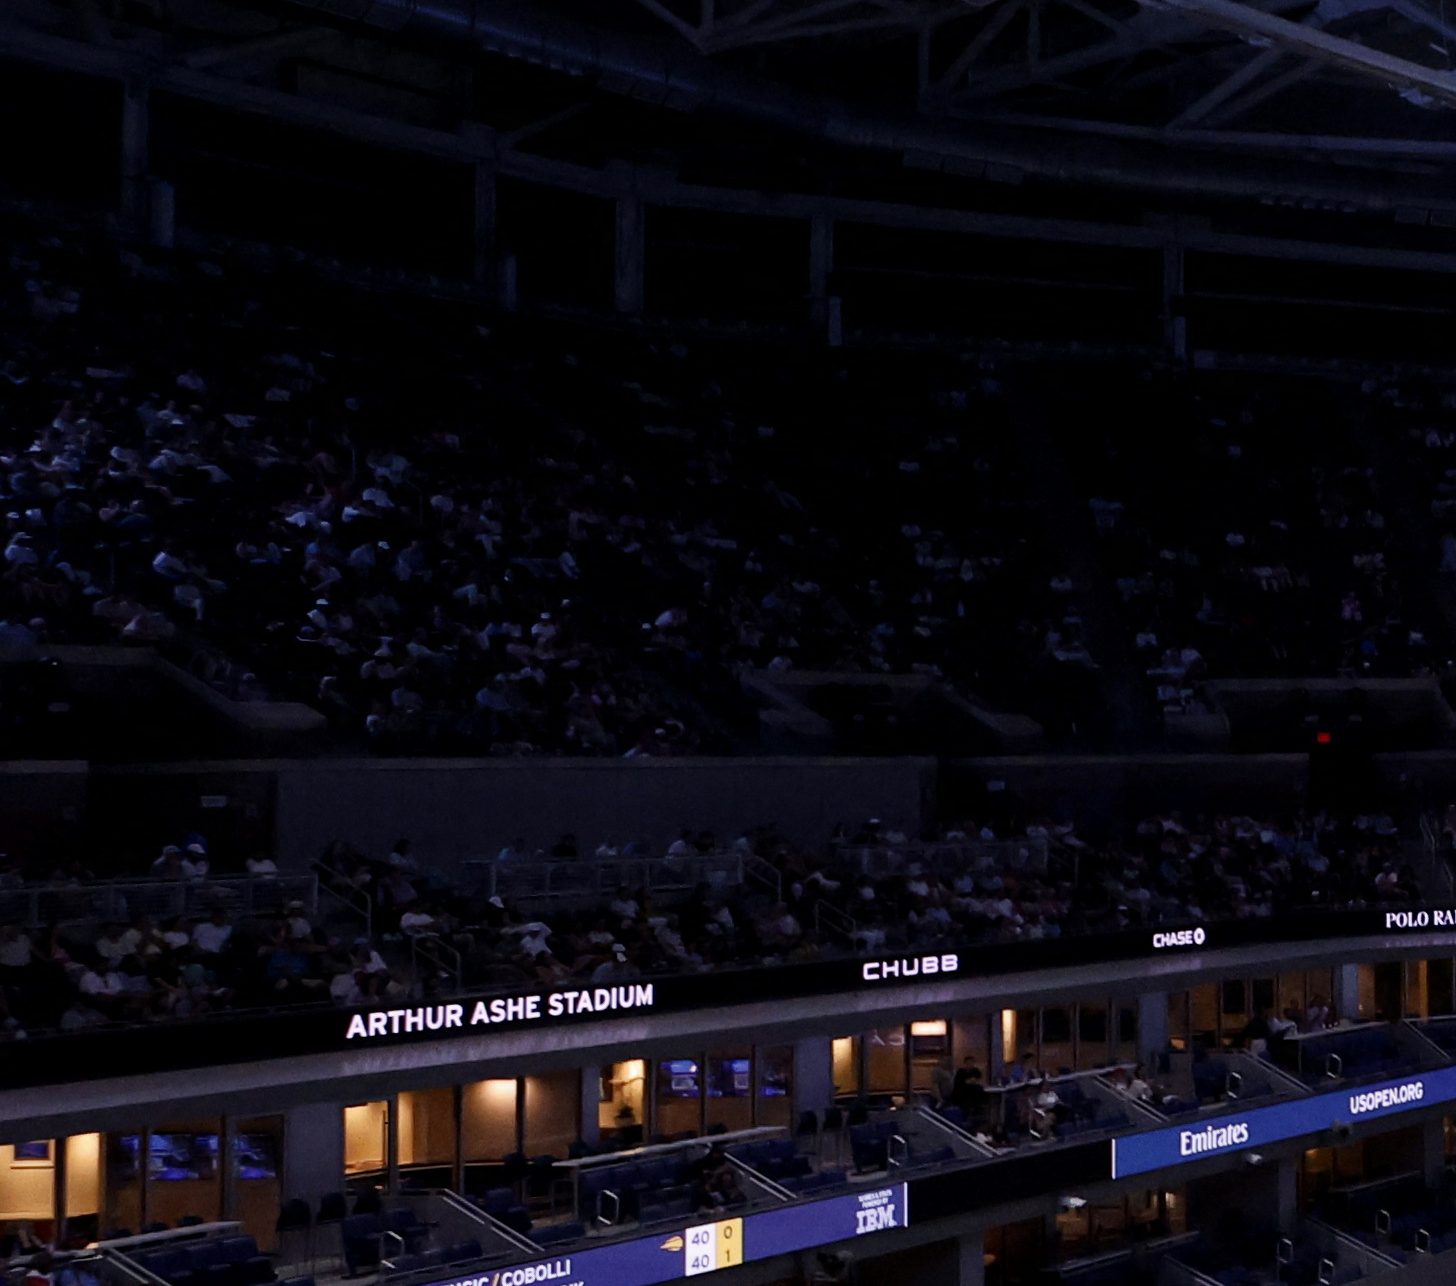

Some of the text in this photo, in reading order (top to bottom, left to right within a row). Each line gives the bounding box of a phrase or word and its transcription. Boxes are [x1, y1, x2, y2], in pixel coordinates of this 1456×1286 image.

[1386, 912, 1429, 928] POLO
[1153, 931, 1193, 947] CHASE
[863, 955, 957, 980] CHUBB
[347, 984, 653, 1038] ARTHUR ASHE STADIUM
[1350, 1082, 1423, 1114] USOPEN.ORG
[1181, 1123, 1248, 1155] Emirates
[856, 1203, 898, 1234] IBM
[691, 1230, 710, 1245] 40
[723, 1225, 733, 1240] 0
[691, 1253, 710, 1269] 40
[725, 1249, 732, 1264] 1
